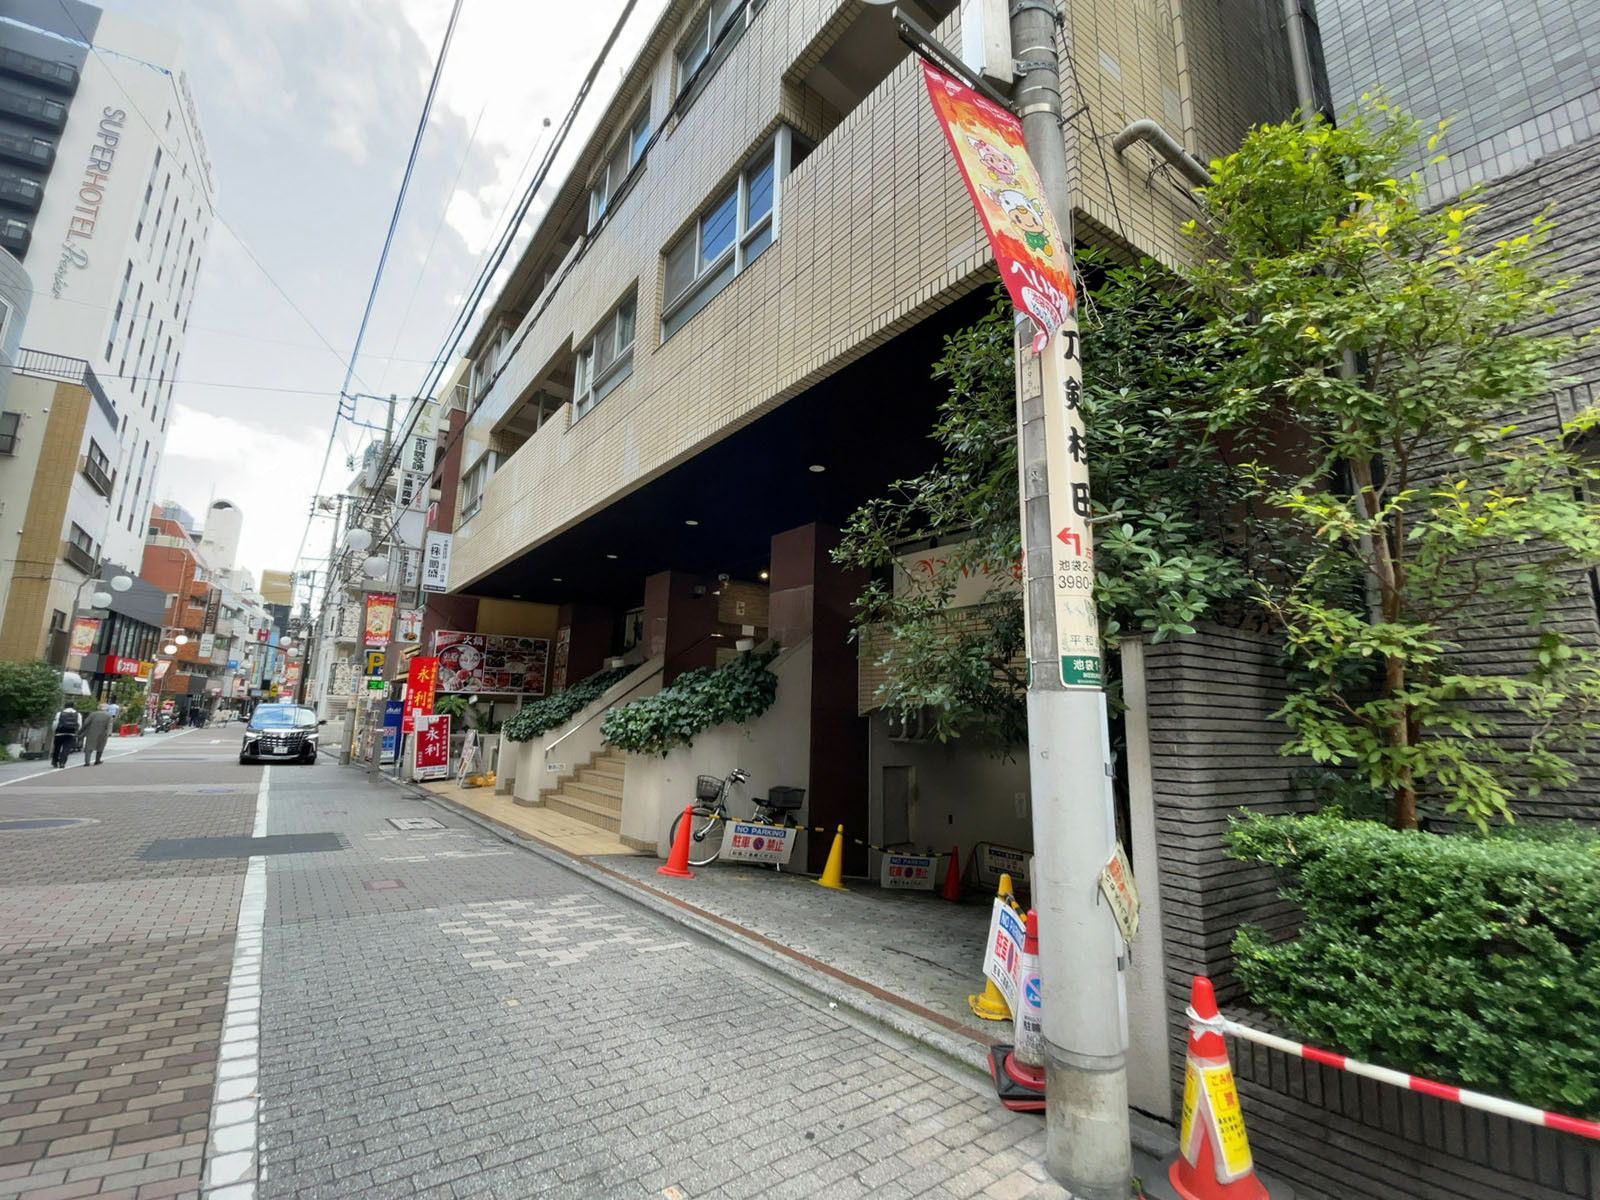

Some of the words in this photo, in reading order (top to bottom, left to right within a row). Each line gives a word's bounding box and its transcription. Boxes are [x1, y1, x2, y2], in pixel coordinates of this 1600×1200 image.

[414, 665, 430, 707] 永利
[425, 725, 441, 758] 永利
[732, 834, 751, 848] 駐車
[765, 838, 784, 852] 禁止
[751, 828, 785, 838] PARKING
